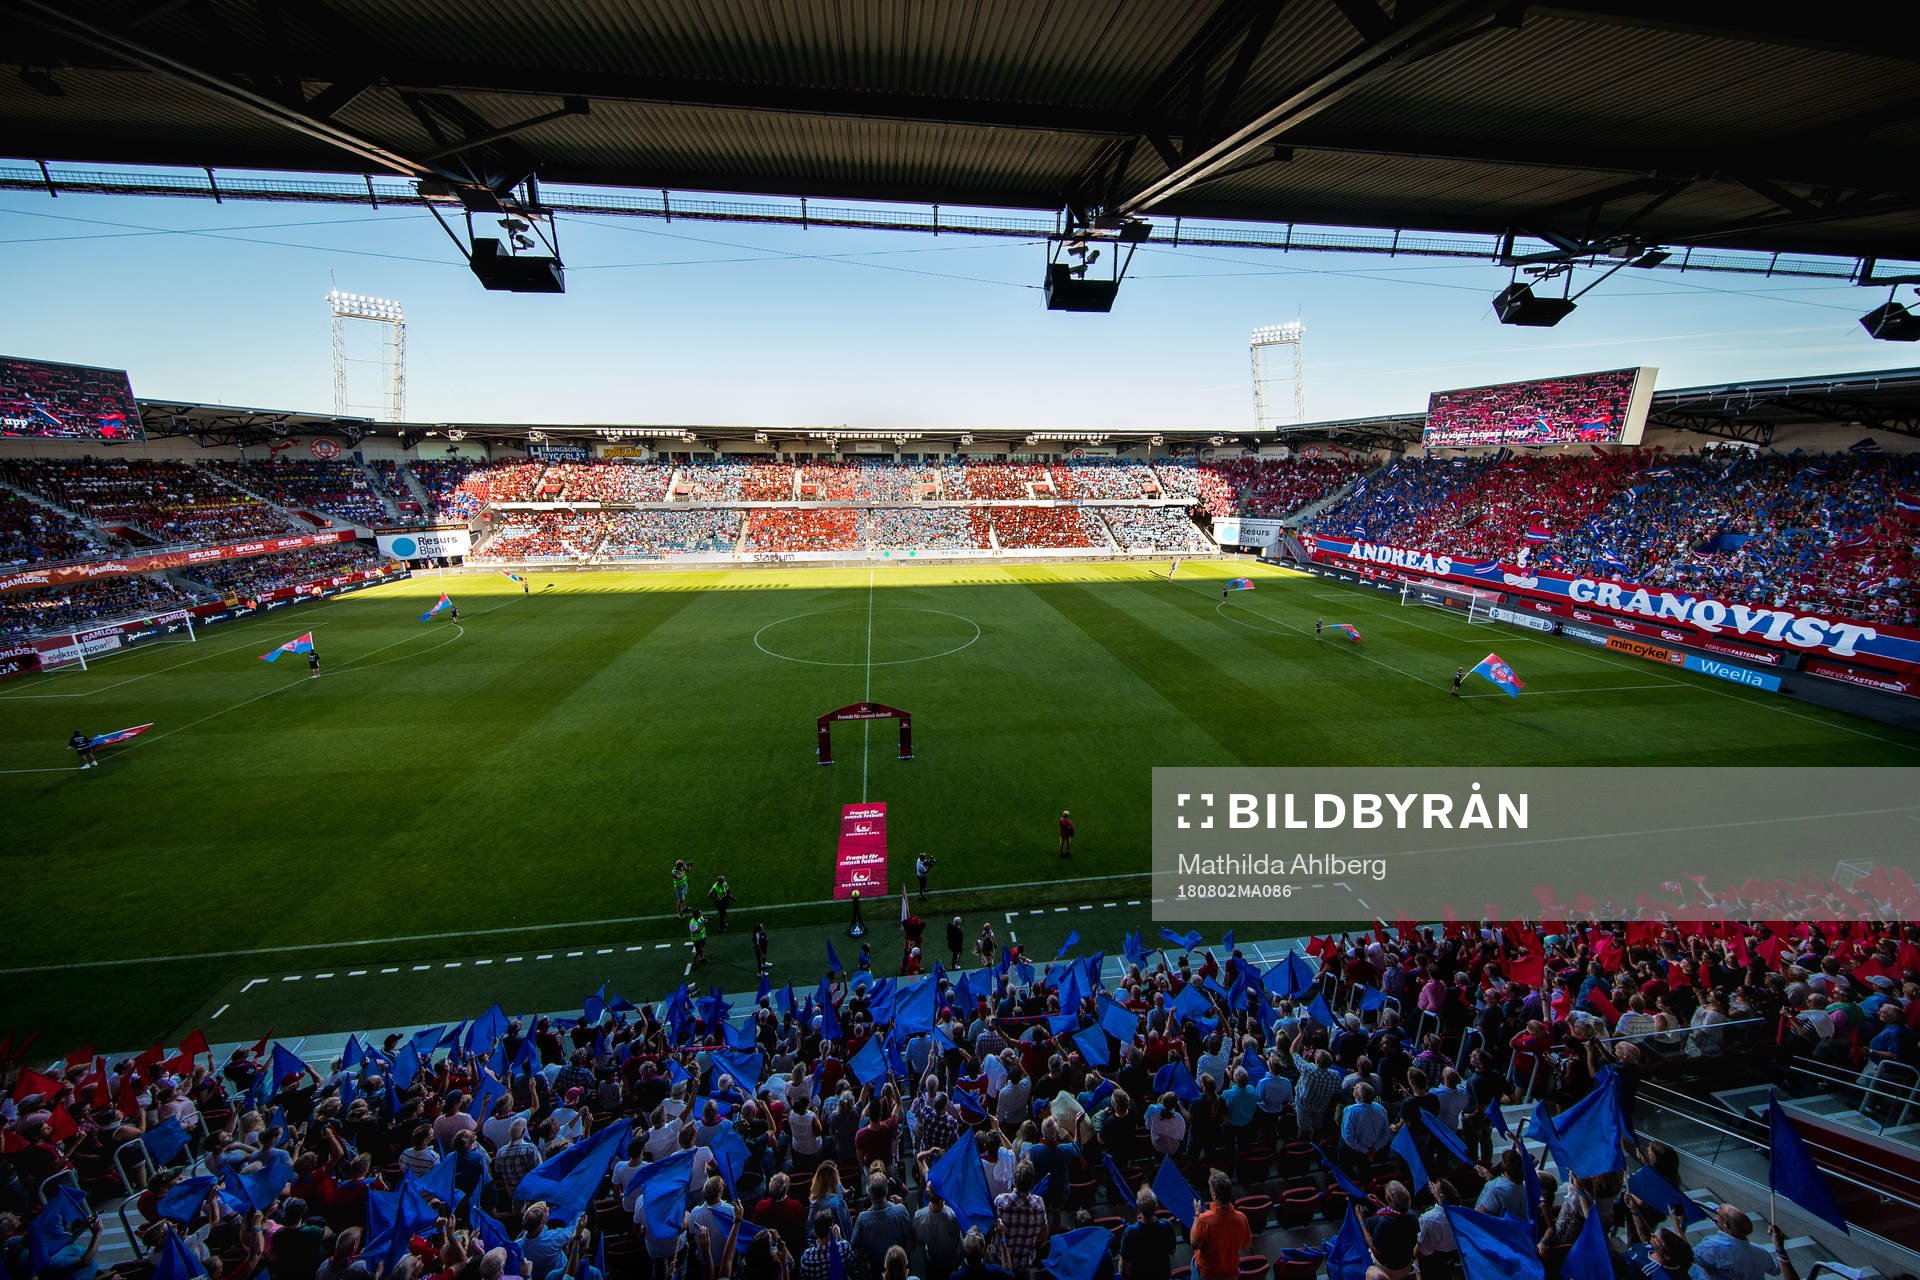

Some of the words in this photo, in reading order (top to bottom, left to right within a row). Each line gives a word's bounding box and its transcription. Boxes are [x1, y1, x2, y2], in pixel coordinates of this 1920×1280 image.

[1240, 527, 1270, 536] Resurs
[417, 536, 458, 547] Resurs
[1240, 535, 1261, 543] Bank
[419, 546, 448, 555] Bank
[1348, 541, 1453, 576] ANDREAS
[1568, 579, 1877, 656] GRANQVIST
[1573, 611, 1592, 621] Carlsberg
[1615, 620, 1636, 630] Carlsberg
[1661, 630, 1684, 641] Carlsberg
[1611, 639, 1633, 651] min
[1634, 643, 1668, 660] cykel
[1701, 659, 1762, 686] Weelia
